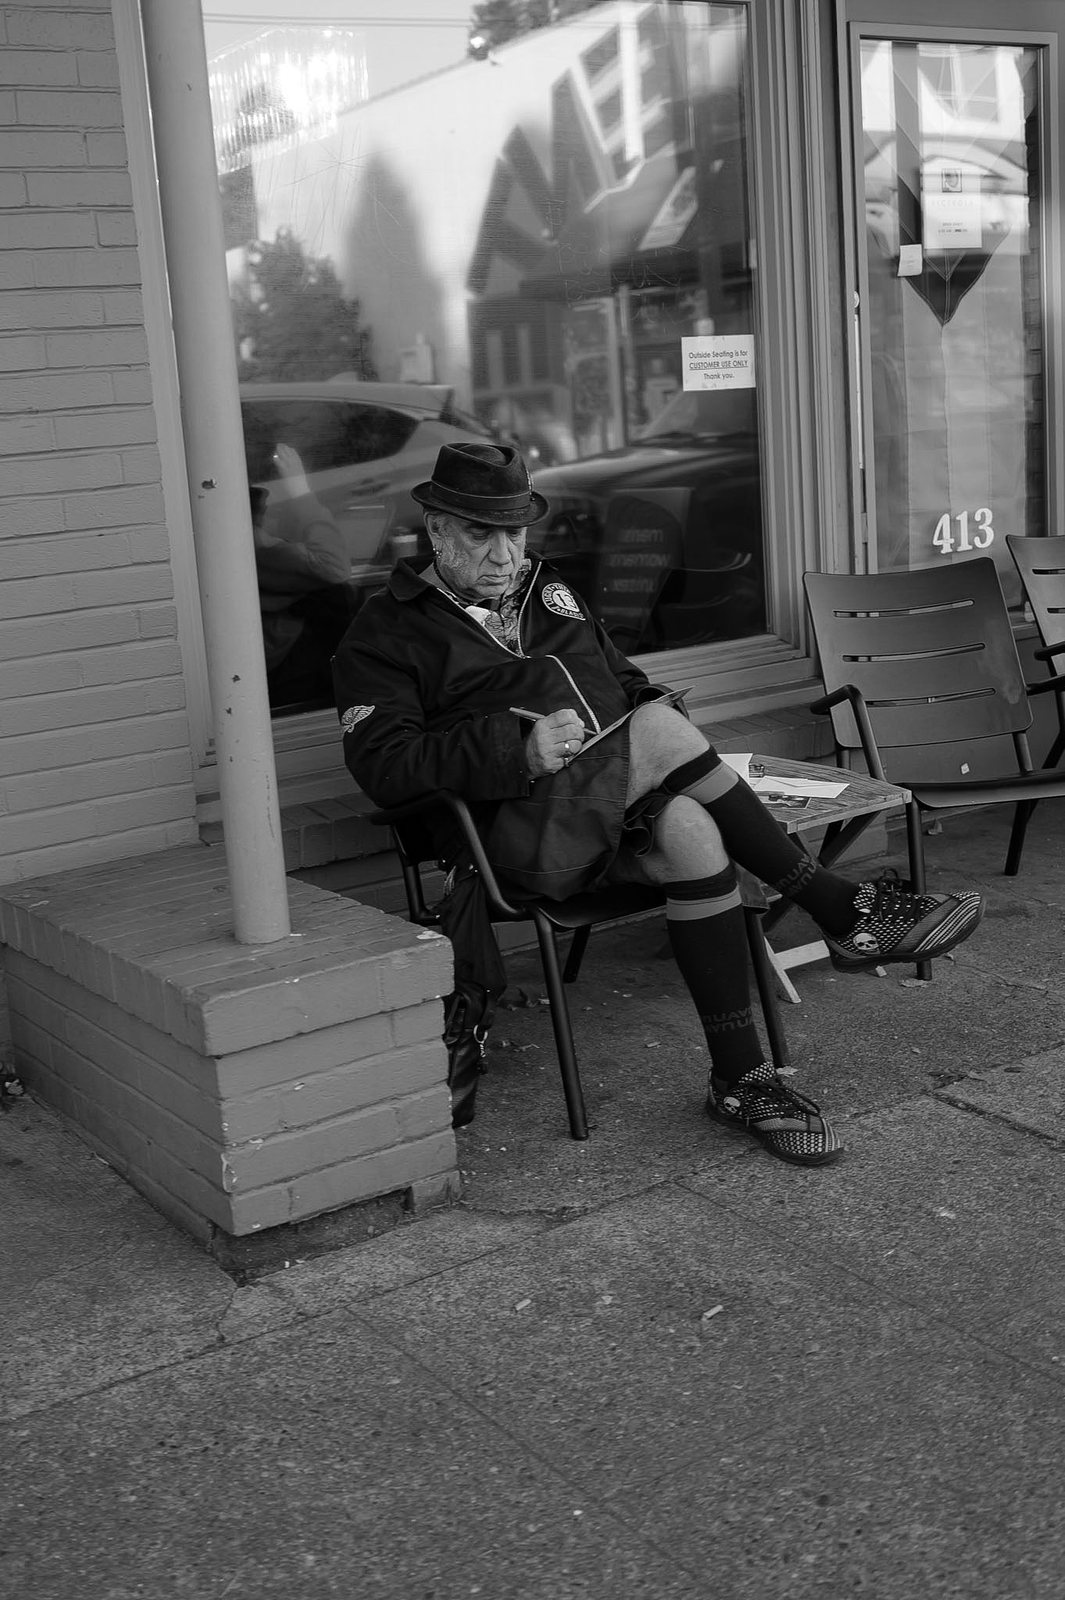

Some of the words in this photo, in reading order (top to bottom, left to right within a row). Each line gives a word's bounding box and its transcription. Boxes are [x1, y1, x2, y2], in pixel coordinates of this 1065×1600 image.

[689, 362, 720, 370] CUSTOMER
[732, 360, 748, 368] ONLY
[932, 507, 995, 554] 413
